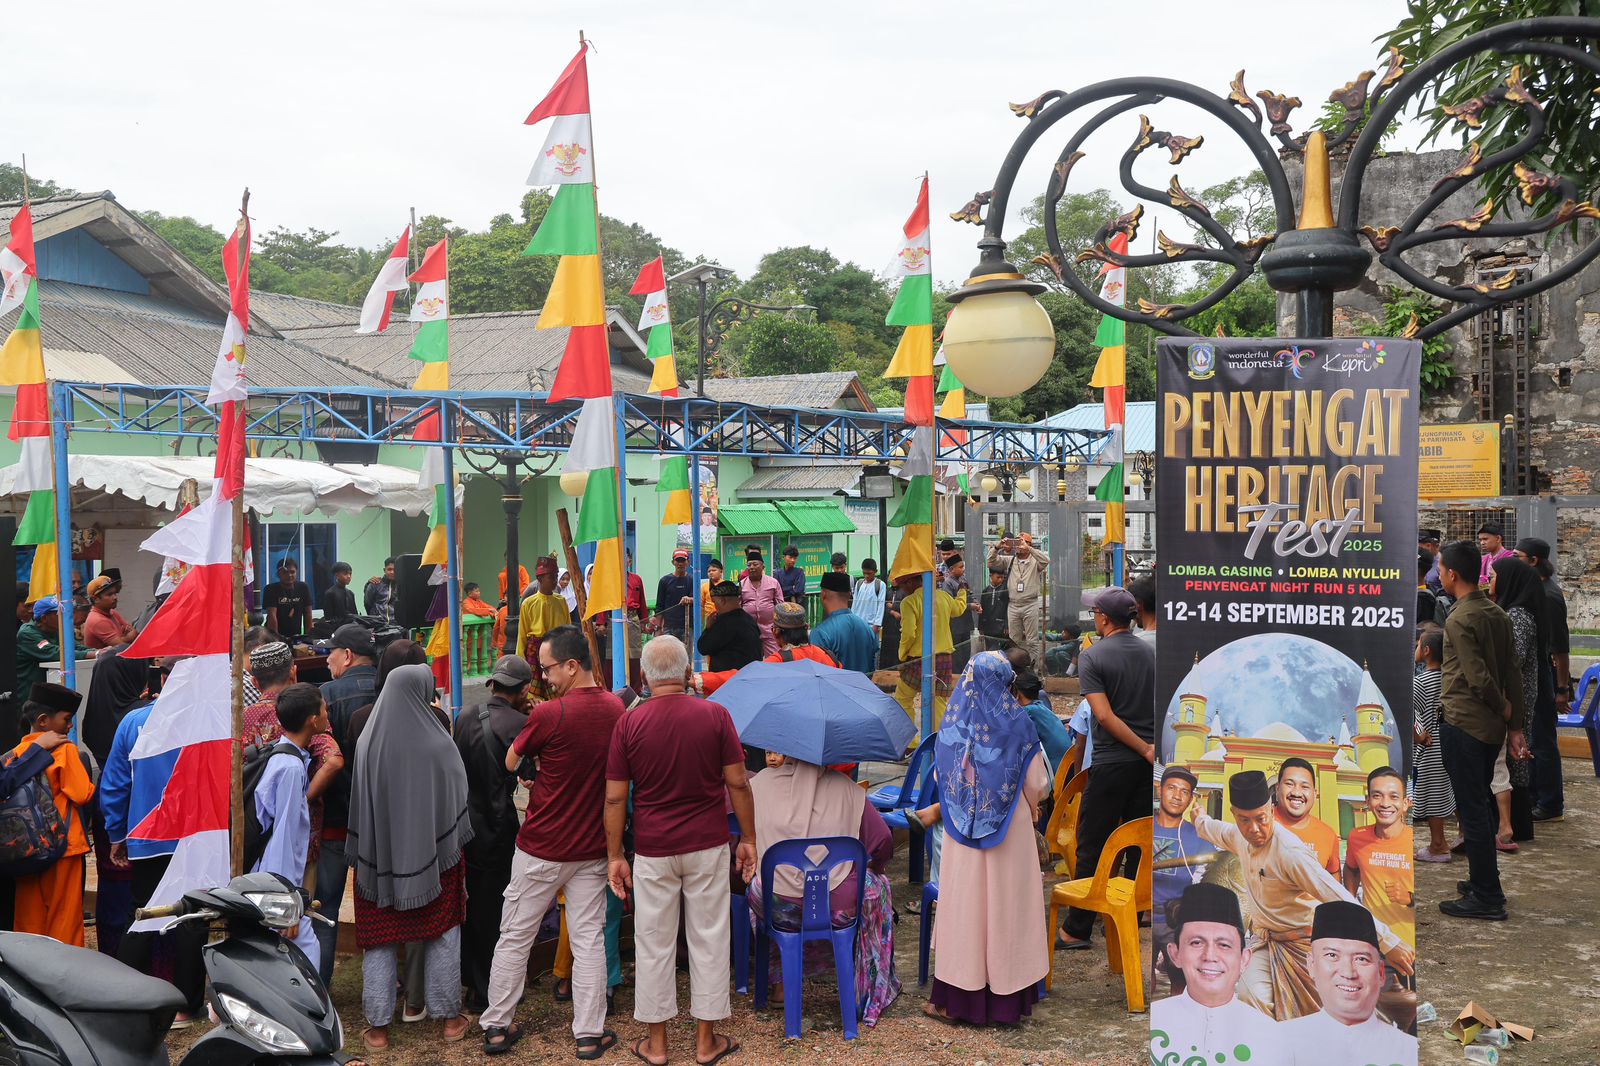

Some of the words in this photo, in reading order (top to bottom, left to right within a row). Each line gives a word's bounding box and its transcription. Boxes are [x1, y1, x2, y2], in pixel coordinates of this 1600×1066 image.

[1228, 351, 1269, 359] wonderful
[1228, 358, 1284, 369] indonesia
[1322, 353, 1372, 377] Kepri
[1163, 388, 1410, 458] PENYENGAT
[1419, 446, 1443, 456] ABIB
[1185, 464, 1384, 533] HERITAGE
[1237, 501, 1365, 560] Fest
[1343, 540, 1383, 551] 2025
[1168, 565, 1217, 576] LOMBA
[1220, 566, 1273, 577] GASING
[1289, 567, 1338, 578] LOMBA
[1342, 568, 1400, 579] NYULUH
[1185, 580, 1267, 592] PENYENGAT
[1270, 582, 1310, 593] NIGHT
[1314, 583, 1344, 594] RUN
[1347, 584, 1356, 594] 5
[1359, 584, 1381, 595] KM
[1163, 601, 1222, 622] 12-14
[1227, 602, 1345, 626] SEPTEMBER
[1351, 606, 1405, 628] 2025
[1371, 851, 1406, 860] PENYENGAT
[1368, 858, 1385, 867] NIGHT
[1386, 860, 1400, 868] RUN
[1401, 862, 1411, 870] 5K
